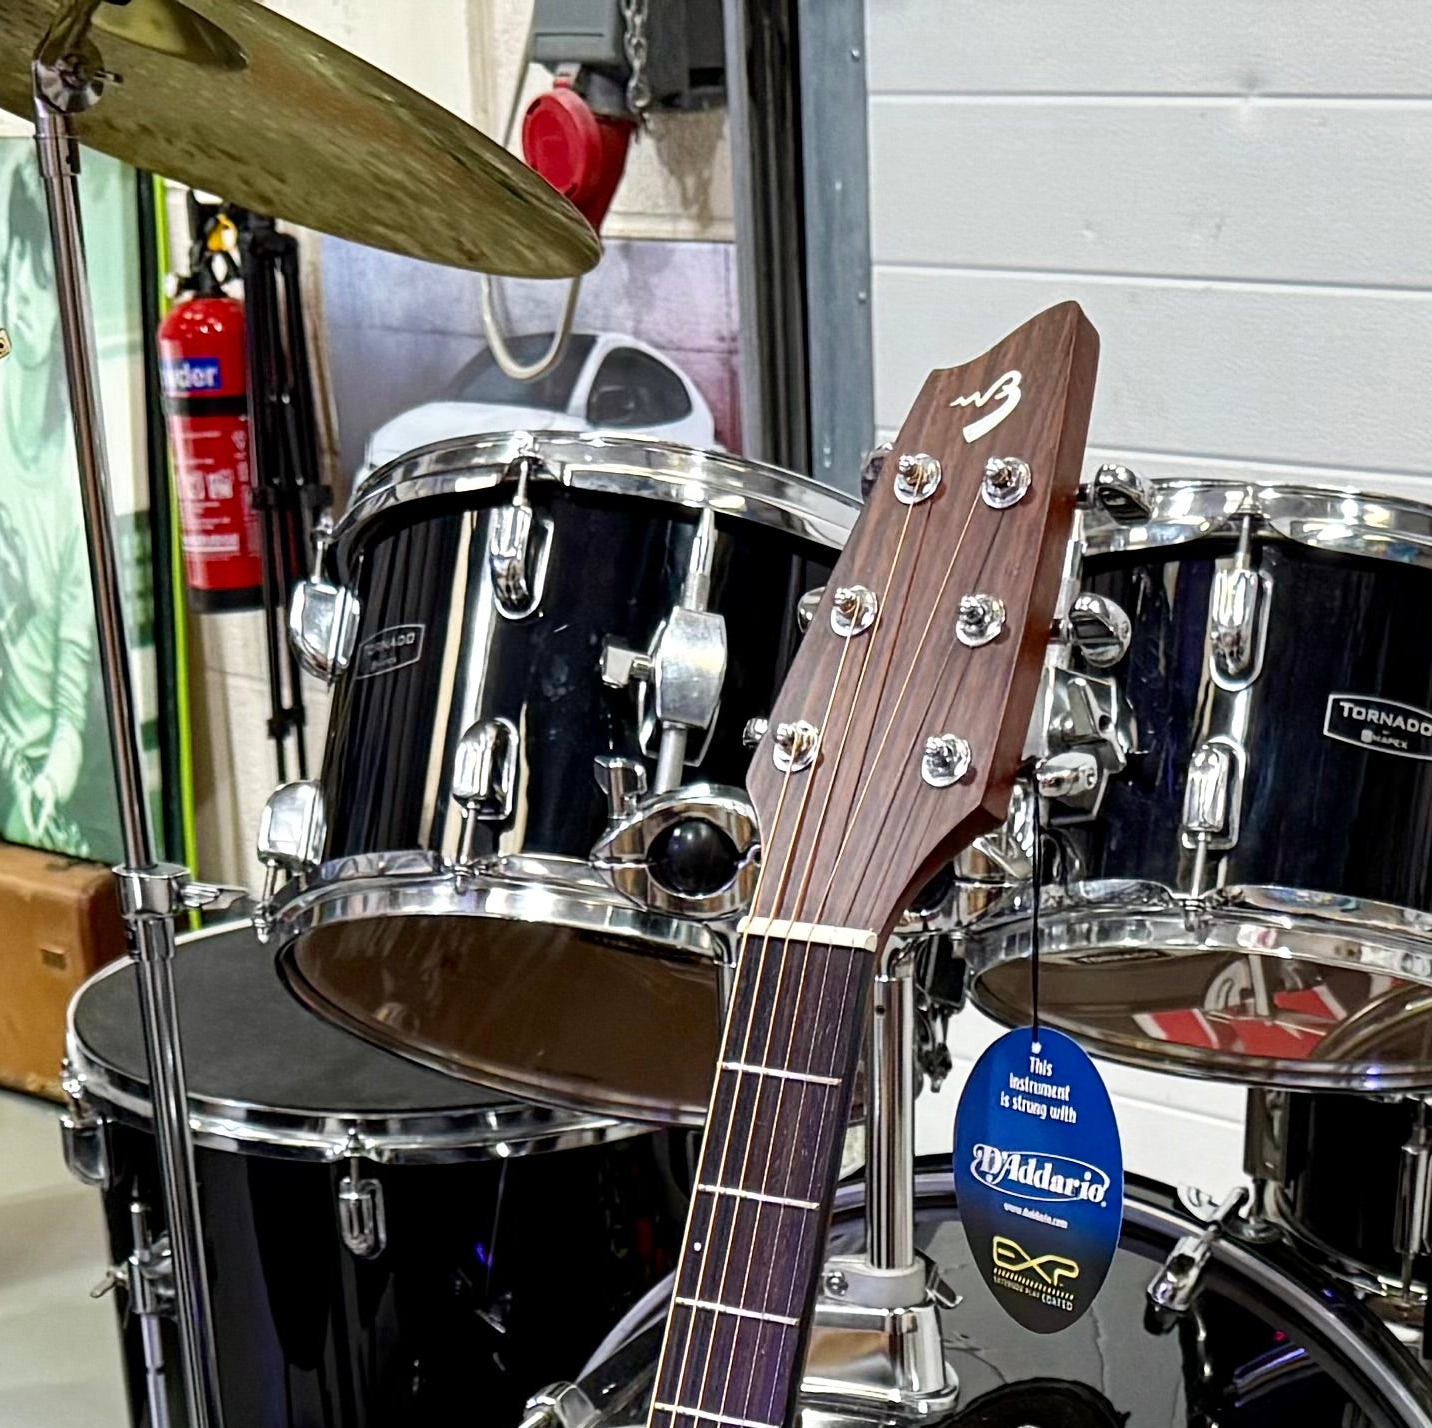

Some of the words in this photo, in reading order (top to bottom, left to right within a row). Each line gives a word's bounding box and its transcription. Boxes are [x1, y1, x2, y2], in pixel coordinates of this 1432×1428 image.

[1029, 1056, 1053, 1077] This
[1012, 1094, 1047, 1120] strung
[1049, 1105, 1077, 1124] with
[971, 1143, 1105, 1204] D'Addario
[992, 1235, 1080, 1287] EXP
